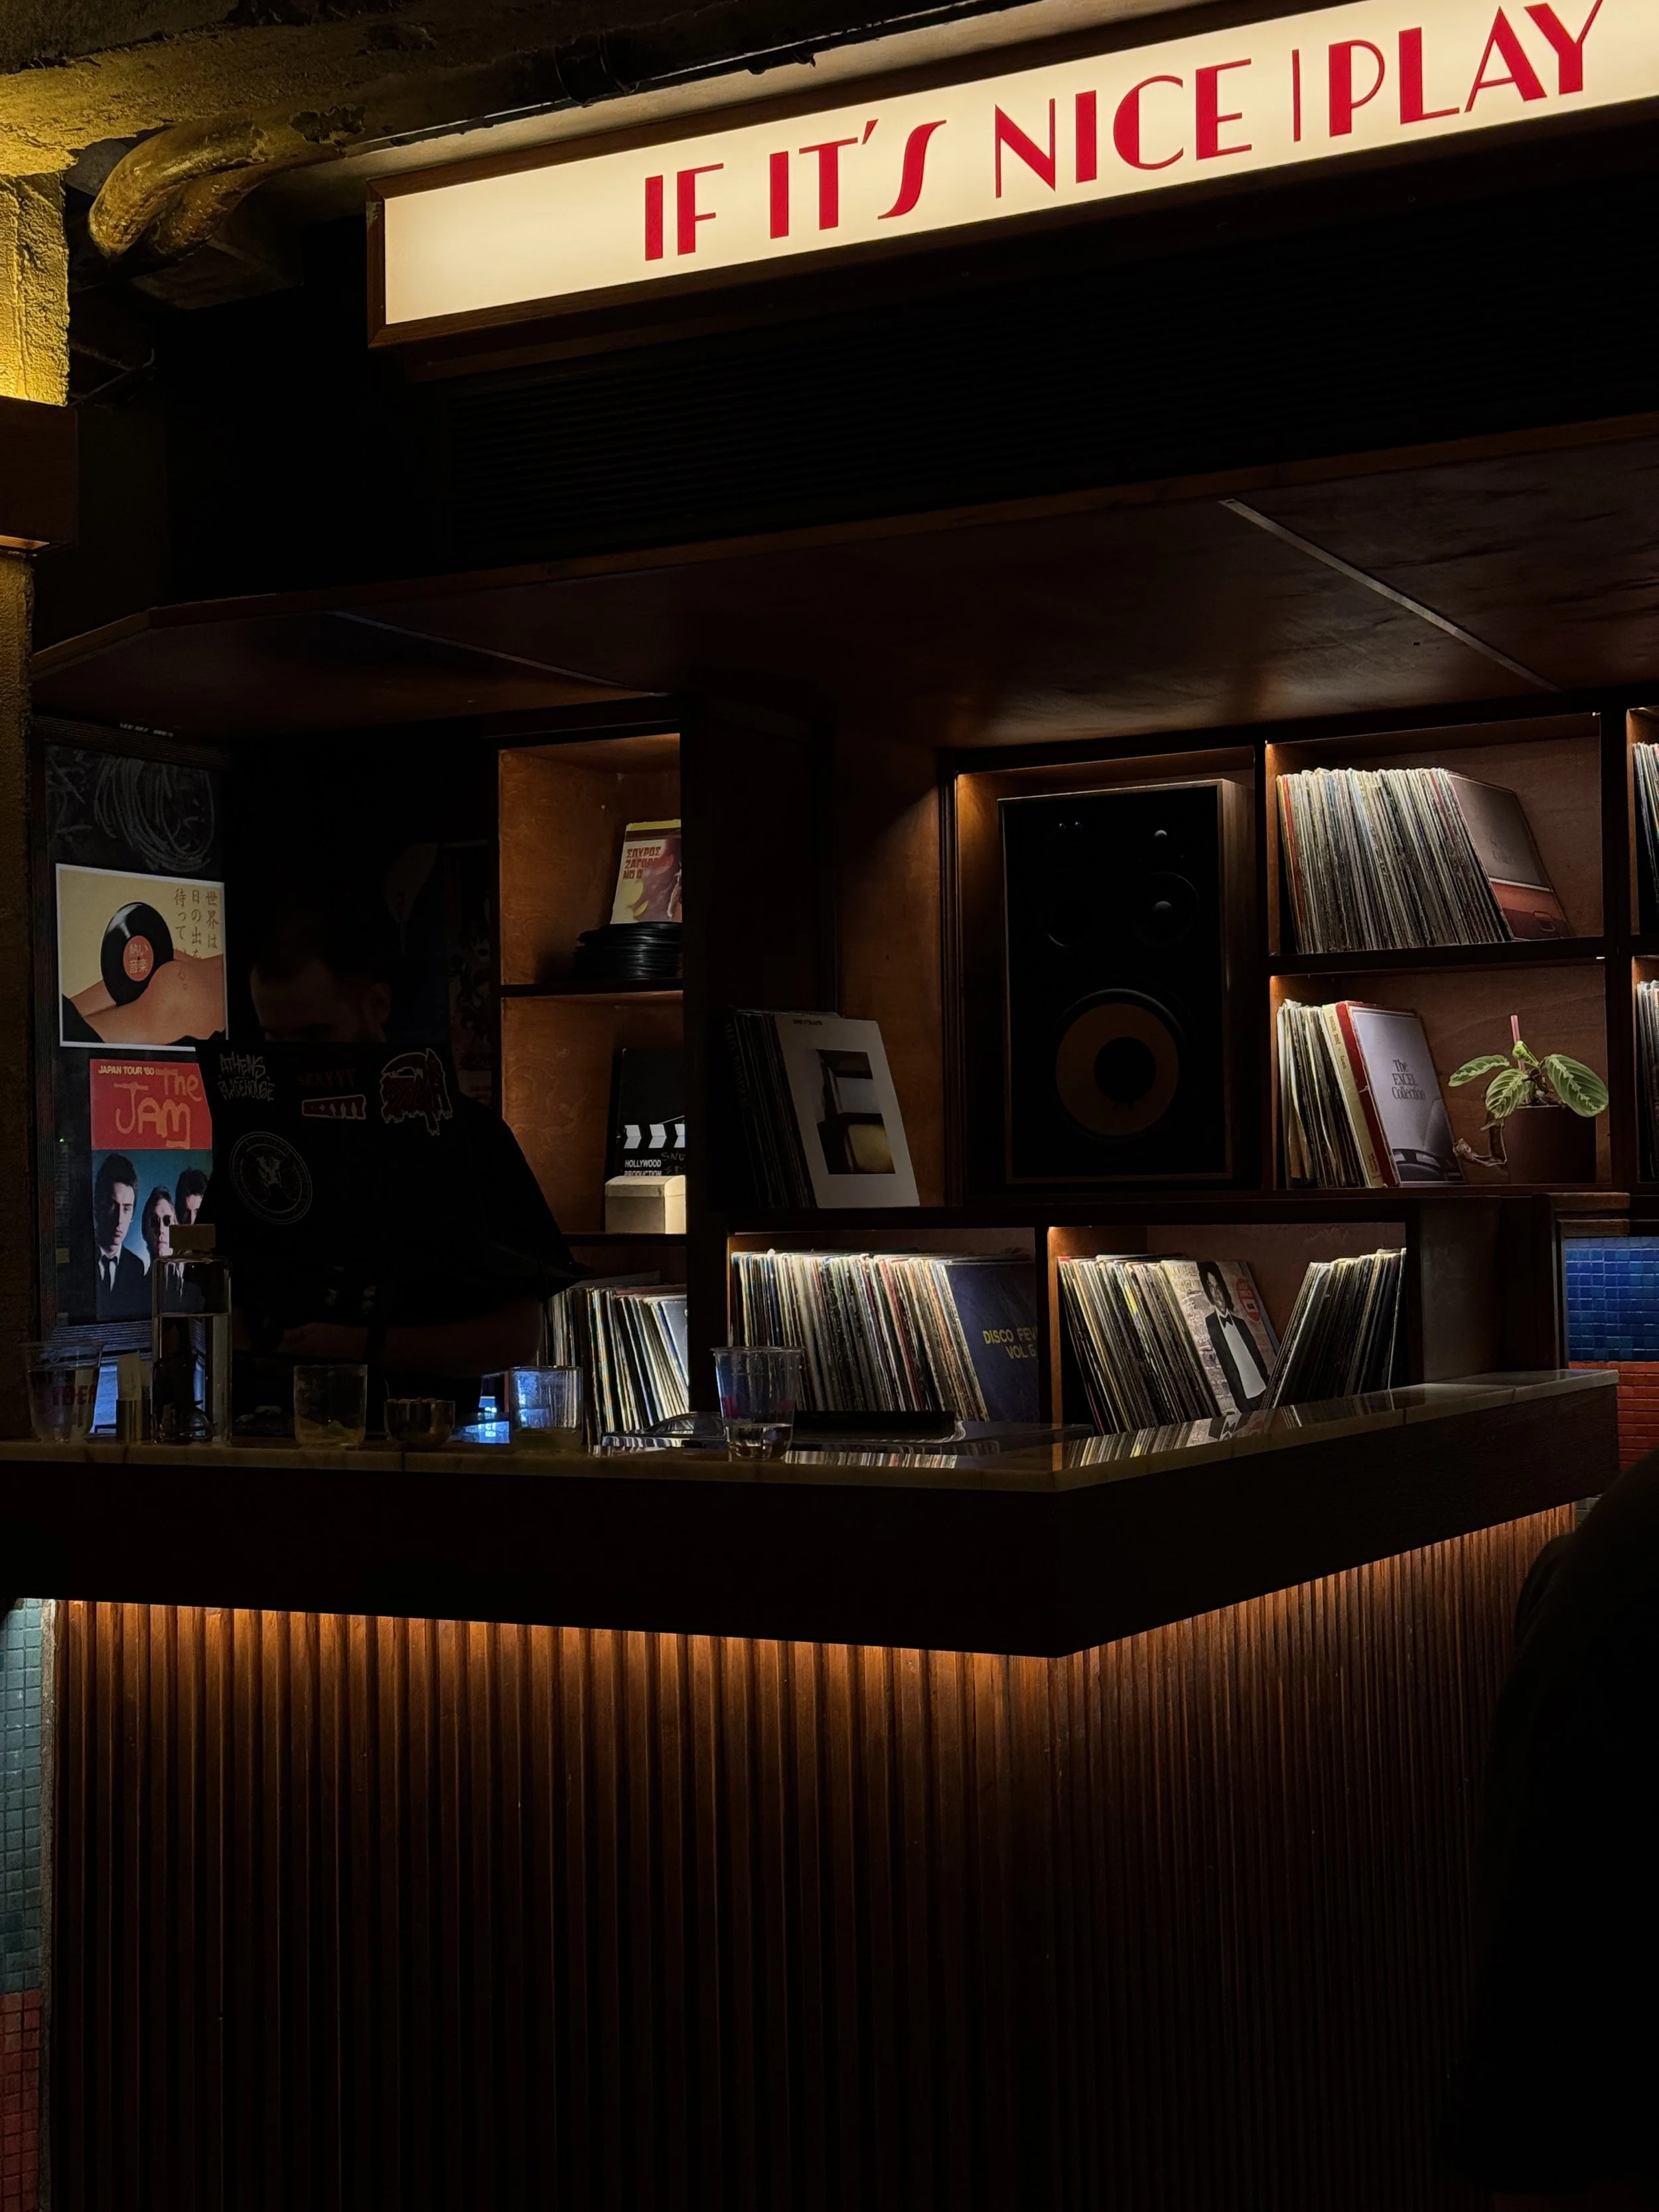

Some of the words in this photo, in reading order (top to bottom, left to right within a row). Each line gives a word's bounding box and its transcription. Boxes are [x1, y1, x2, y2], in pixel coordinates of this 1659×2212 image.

[645, 163, 724, 261] IF
[769, 119, 947, 240] IT'S
[995, 58, 1252, 198] NICE
[1329, 0, 1603, 137] PLAY
[98, 1065, 121, 1074] JAPAN
[1392, 1059, 1409, 1072] The
[155, 1068, 202, 1102] The
[1392, 1073, 1419, 1086] EXCEL
[1391, 1086, 1427, 1100] Collection
[624, 1159, 662, 1168] HOLLYWOOD
[982, 1329, 1014, 1345] DISCO
[1017, 1327, 1038, 1341] FEV
[1005, 1345, 1029, 1360] VOL
